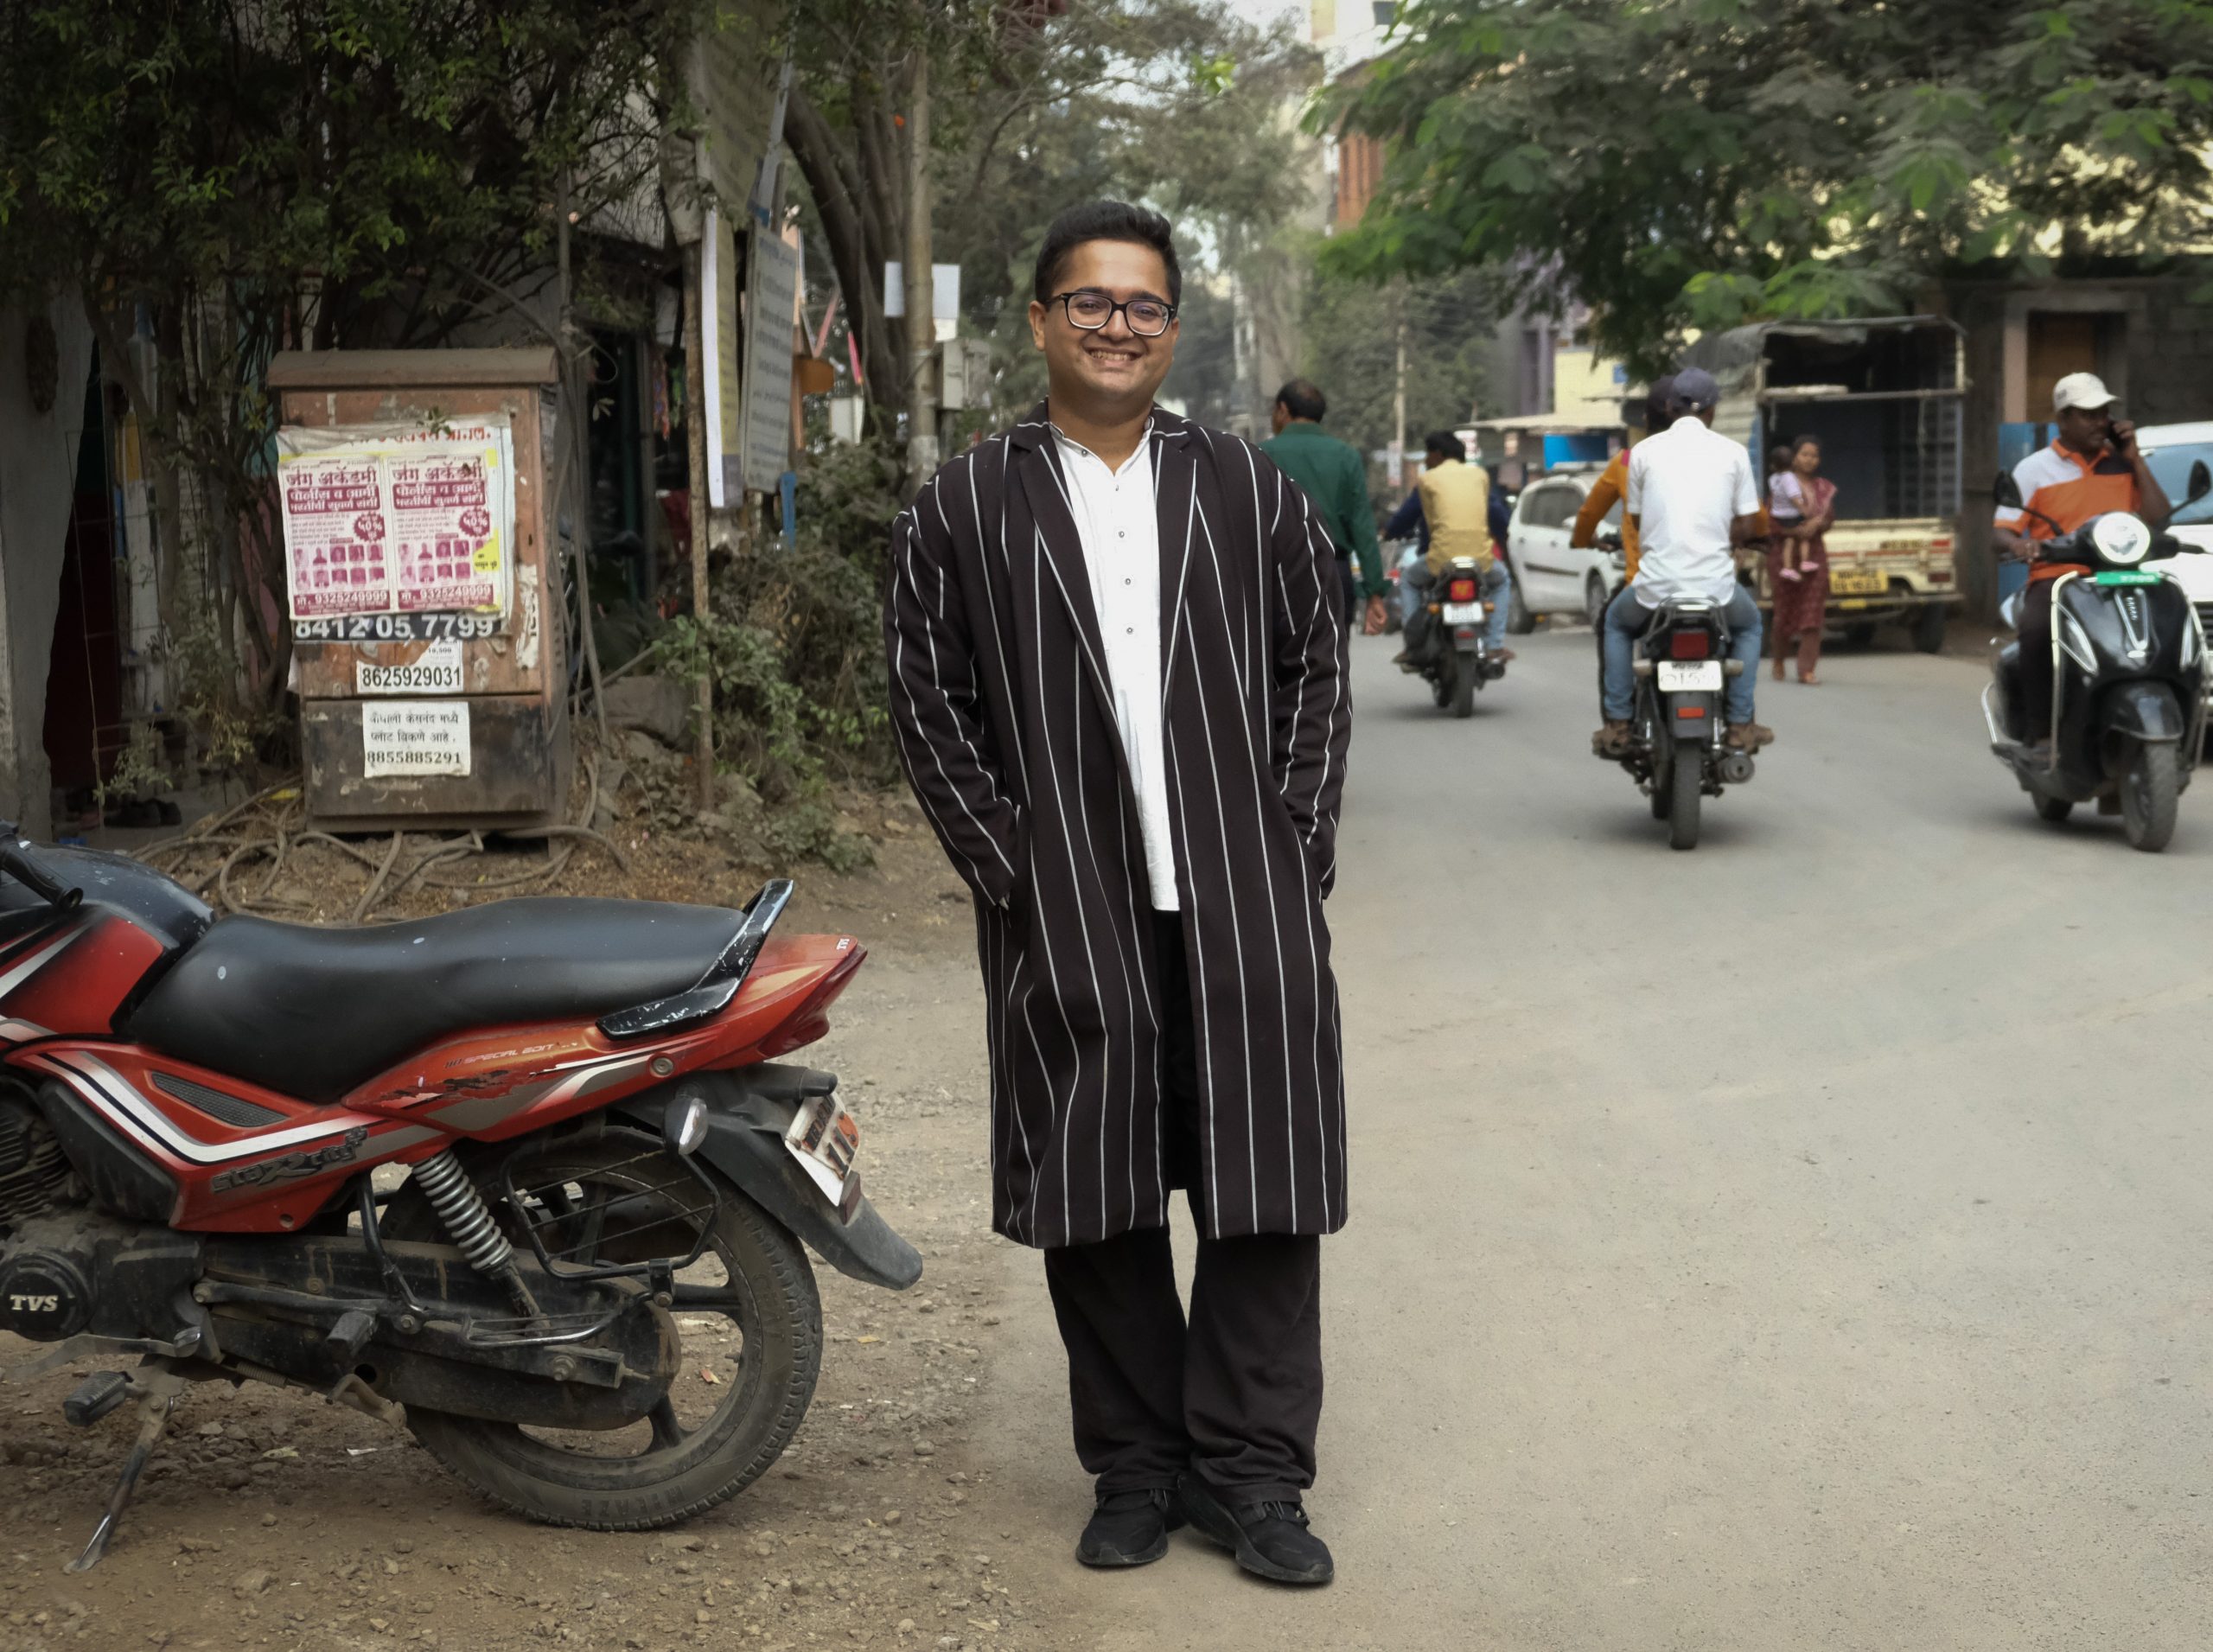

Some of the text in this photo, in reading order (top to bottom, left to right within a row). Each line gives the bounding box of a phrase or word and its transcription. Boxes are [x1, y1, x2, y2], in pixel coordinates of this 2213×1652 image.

[361, 667, 460, 686] 8625929031
[367, 751, 461, 763] 8855885291
[463, 1049, 520, 1064] SPECIAL
[10, 1294, 59, 1311] TVS
